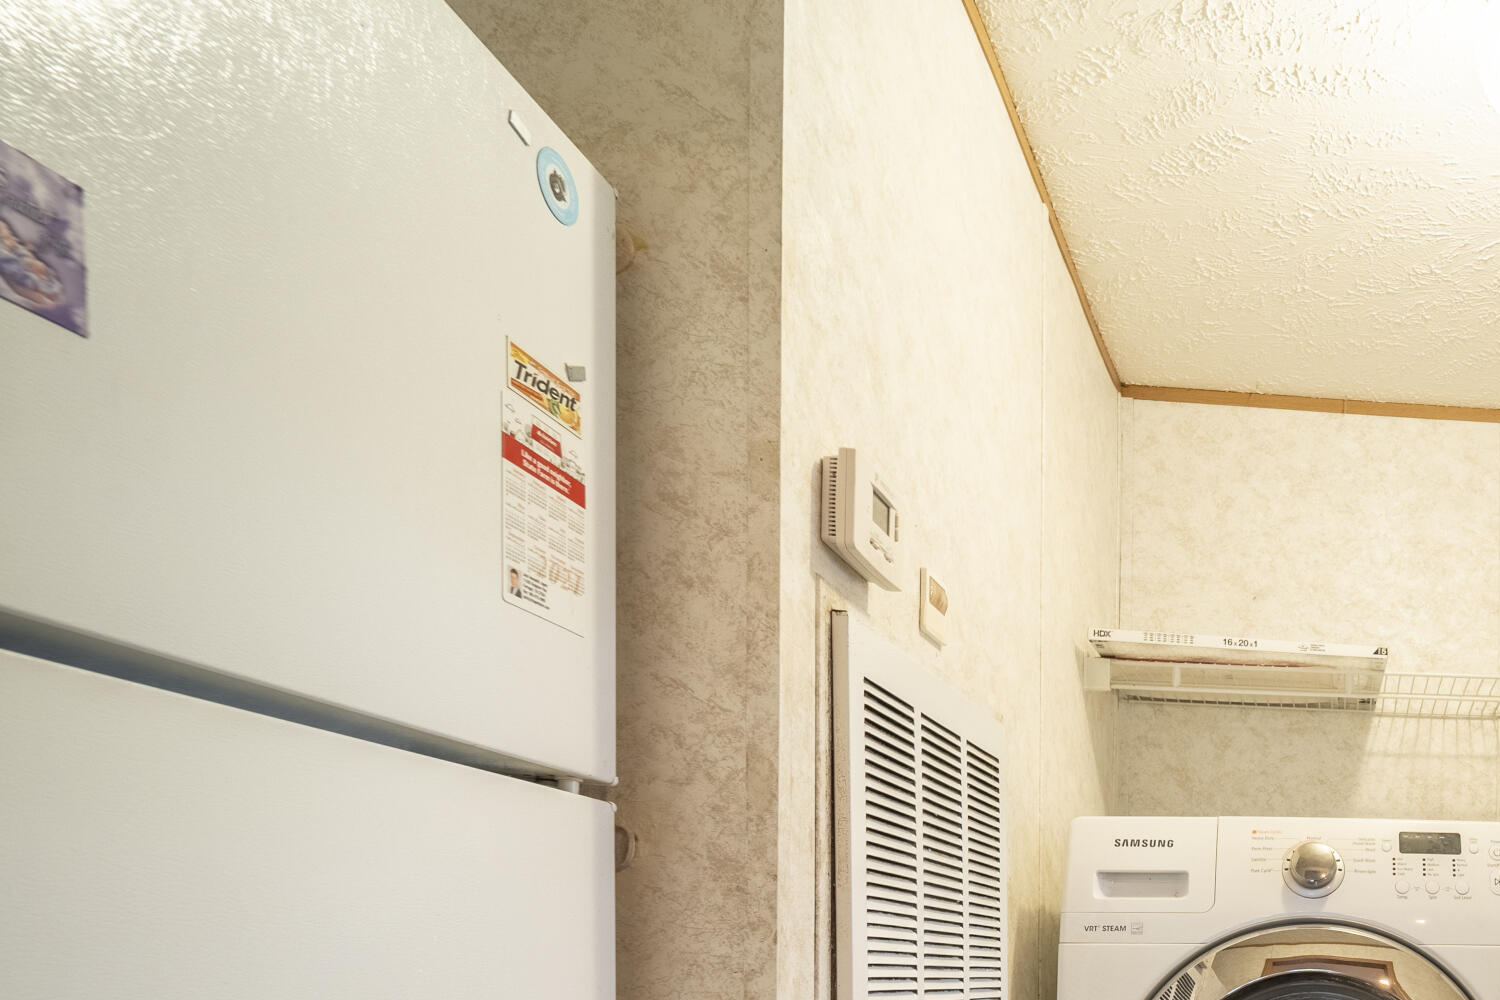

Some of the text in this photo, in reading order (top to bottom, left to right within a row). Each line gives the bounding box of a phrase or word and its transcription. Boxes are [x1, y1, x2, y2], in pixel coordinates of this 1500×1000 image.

[513, 359, 578, 411] Trident
[1093, 629, 1112, 638] HDX
[1223, 638, 1233, 647] 16
[1238, 639, 1249, 648] 20
[1254, 640, 1258, 648] 1
[1114, 838, 1175, 848] SAMSUNG
